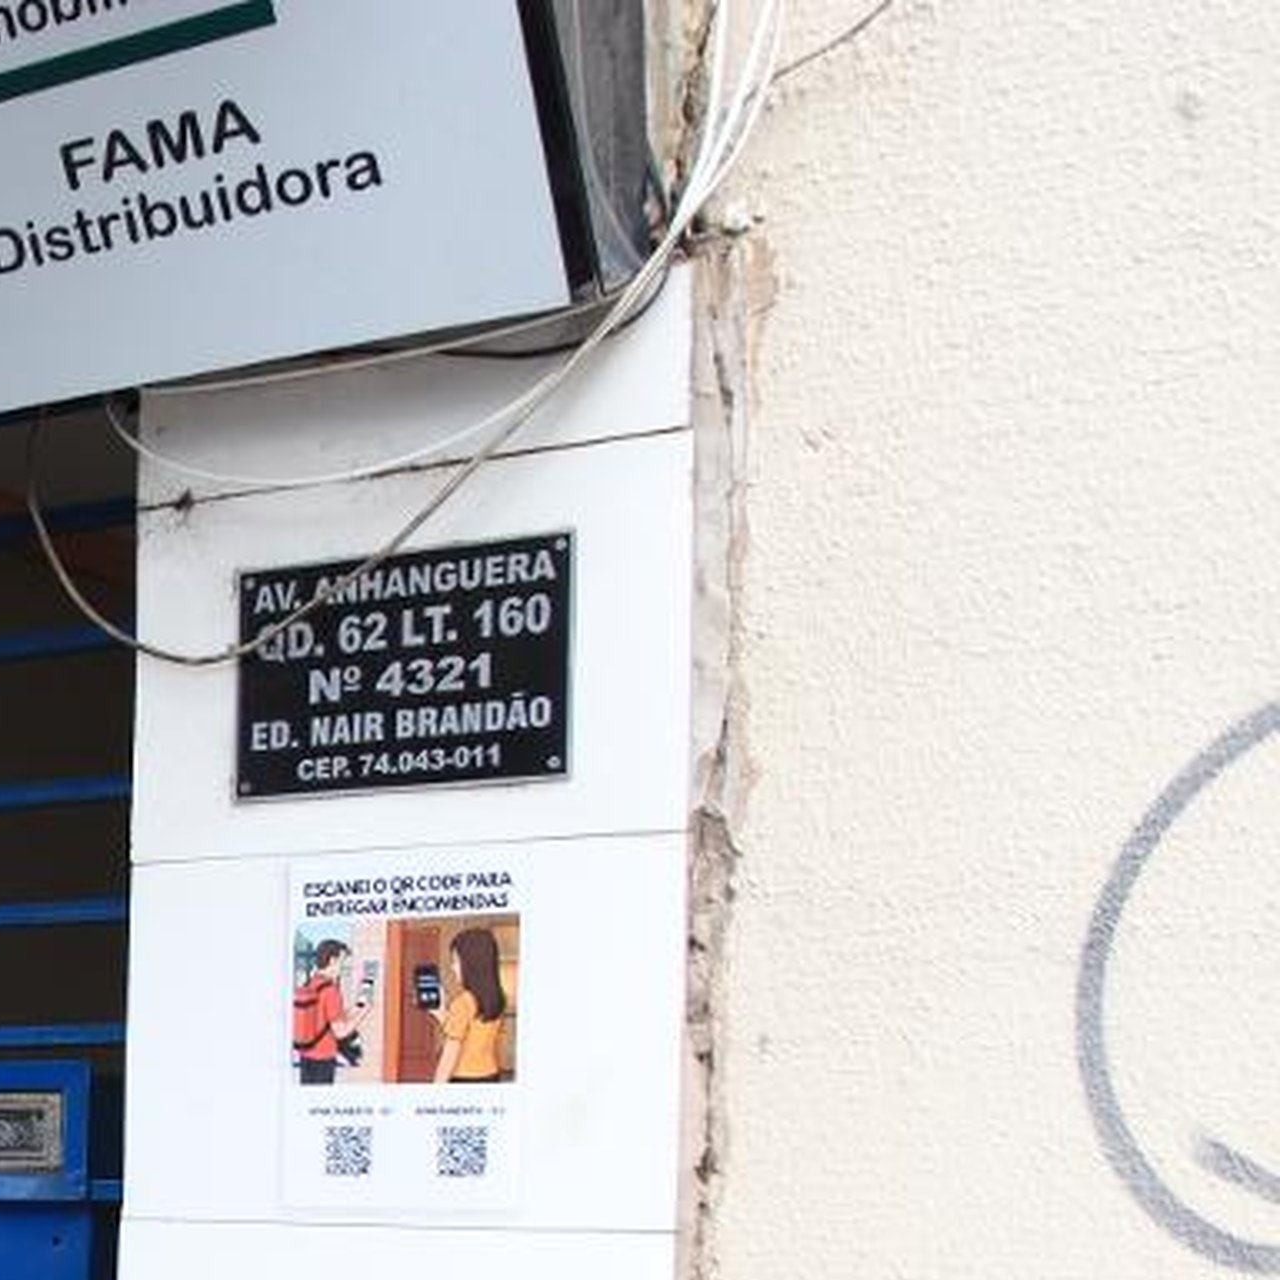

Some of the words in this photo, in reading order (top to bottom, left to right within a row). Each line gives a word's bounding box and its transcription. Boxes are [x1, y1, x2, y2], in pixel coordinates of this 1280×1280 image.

[58, 98, 263, 191] FAMA
[252, 580, 302, 615] AV.
[312, 549, 558, 607] ANHANGUERA
[255, 621, 325, 664] QD.
[339, 612, 389, 655] 62
[400, 604, 458, 649] LT.
[472, 591, 554, 640] 160
[375, 650, 494, 699] 4321
[250, 720, 300, 752] ED.
[310, 709, 386, 748] NAIR
[394, 691, 554, 741] BRANDÃO
[296, 756, 353, 782] CEP.
[359, 743, 502, 776] 74.043-011
[390, 875, 414, 895] QR
[466, 870, 512, 888] PARA
